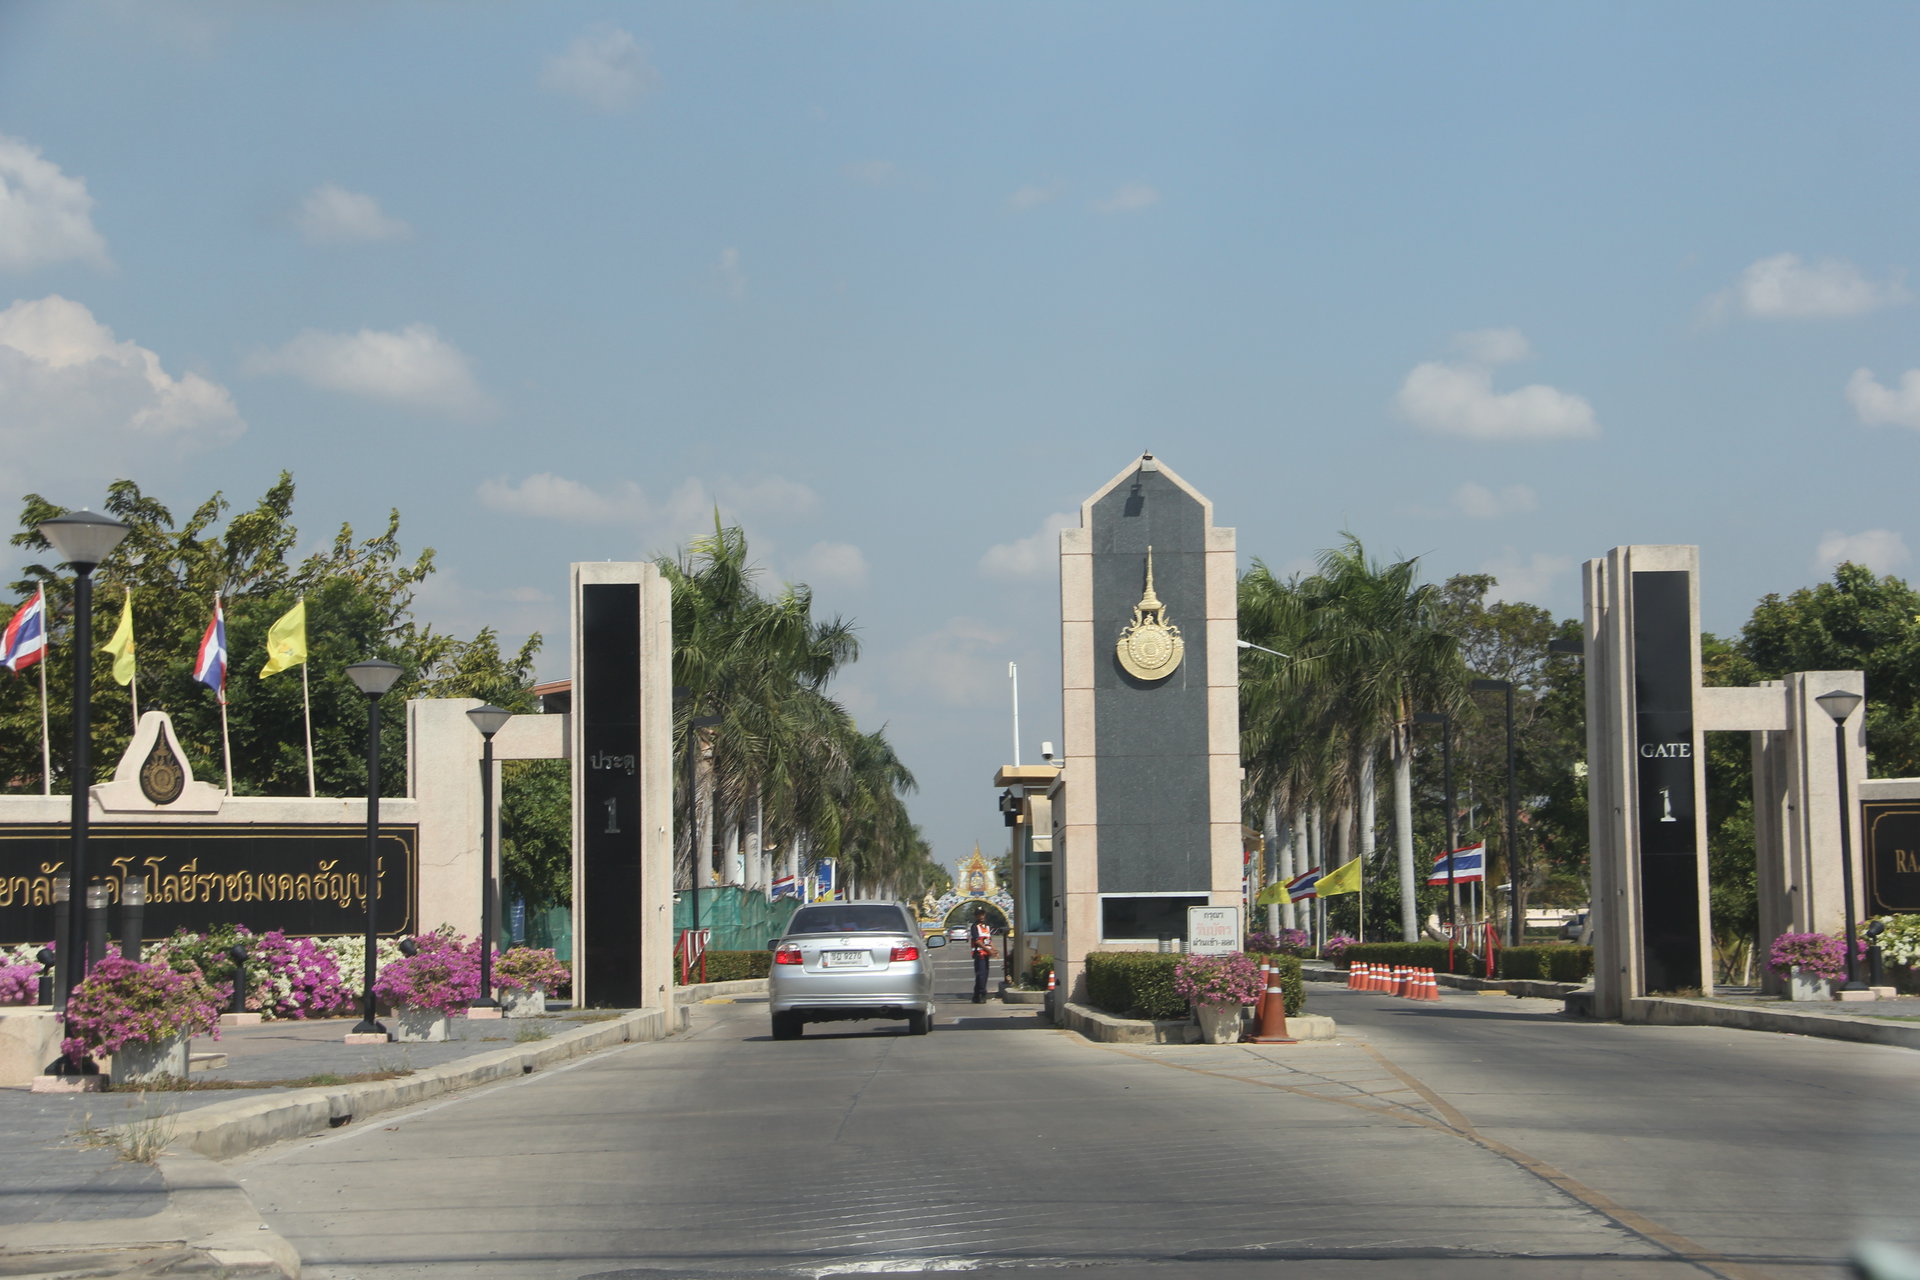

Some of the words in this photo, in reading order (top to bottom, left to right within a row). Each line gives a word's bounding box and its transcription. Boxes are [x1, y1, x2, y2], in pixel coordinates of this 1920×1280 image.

[591, 750, 635, 775] ประตู
[1641, 743, 1691, 758] GATE
[604, 797, 620, 833] 1
[1659, 786, 1677, 822] 1
[1895, 849, 1920, 873] RA
